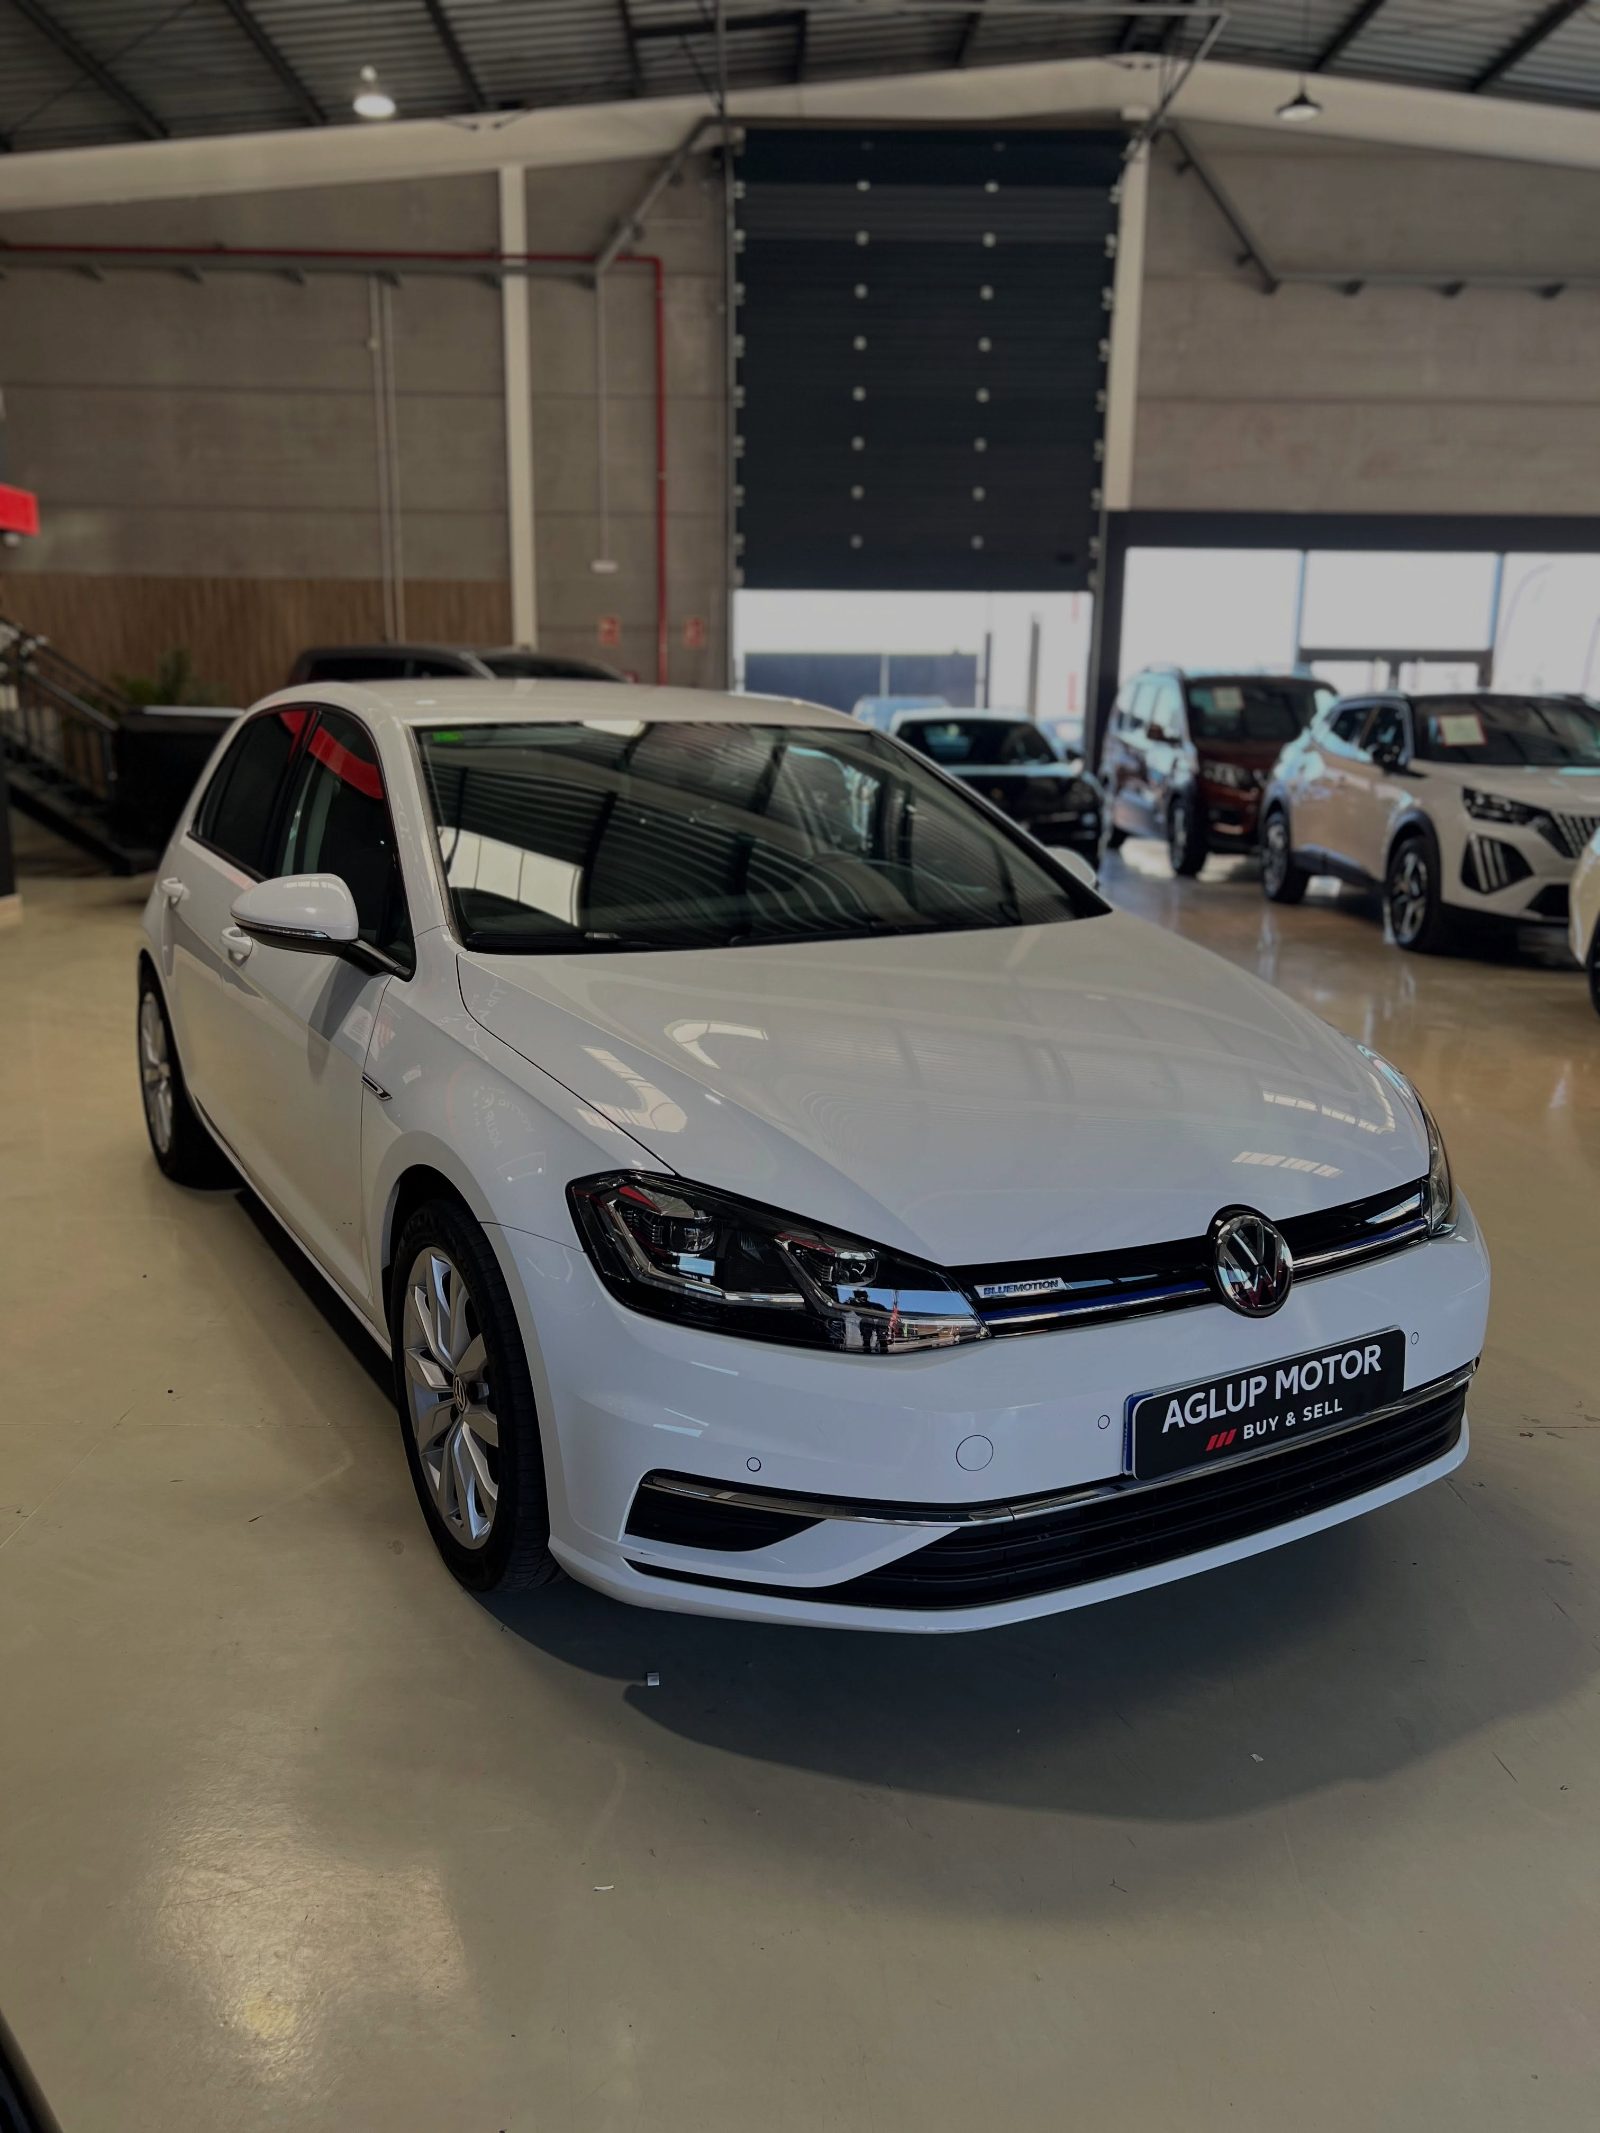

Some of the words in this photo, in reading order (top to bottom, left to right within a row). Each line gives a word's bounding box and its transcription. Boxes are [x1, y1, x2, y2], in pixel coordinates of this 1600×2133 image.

[983, 1279, 1059, 1296] BLUEMOTION
[1161, 1375, 1268, 1434] AGLUP
[1275, 1344, 1382, 1400] MOTOR
[1243, 1415, 1279, 1440] BUY
[1285, 1411, 1296, 1427] &
[1302, 1399, 1343, 1422] SELL
